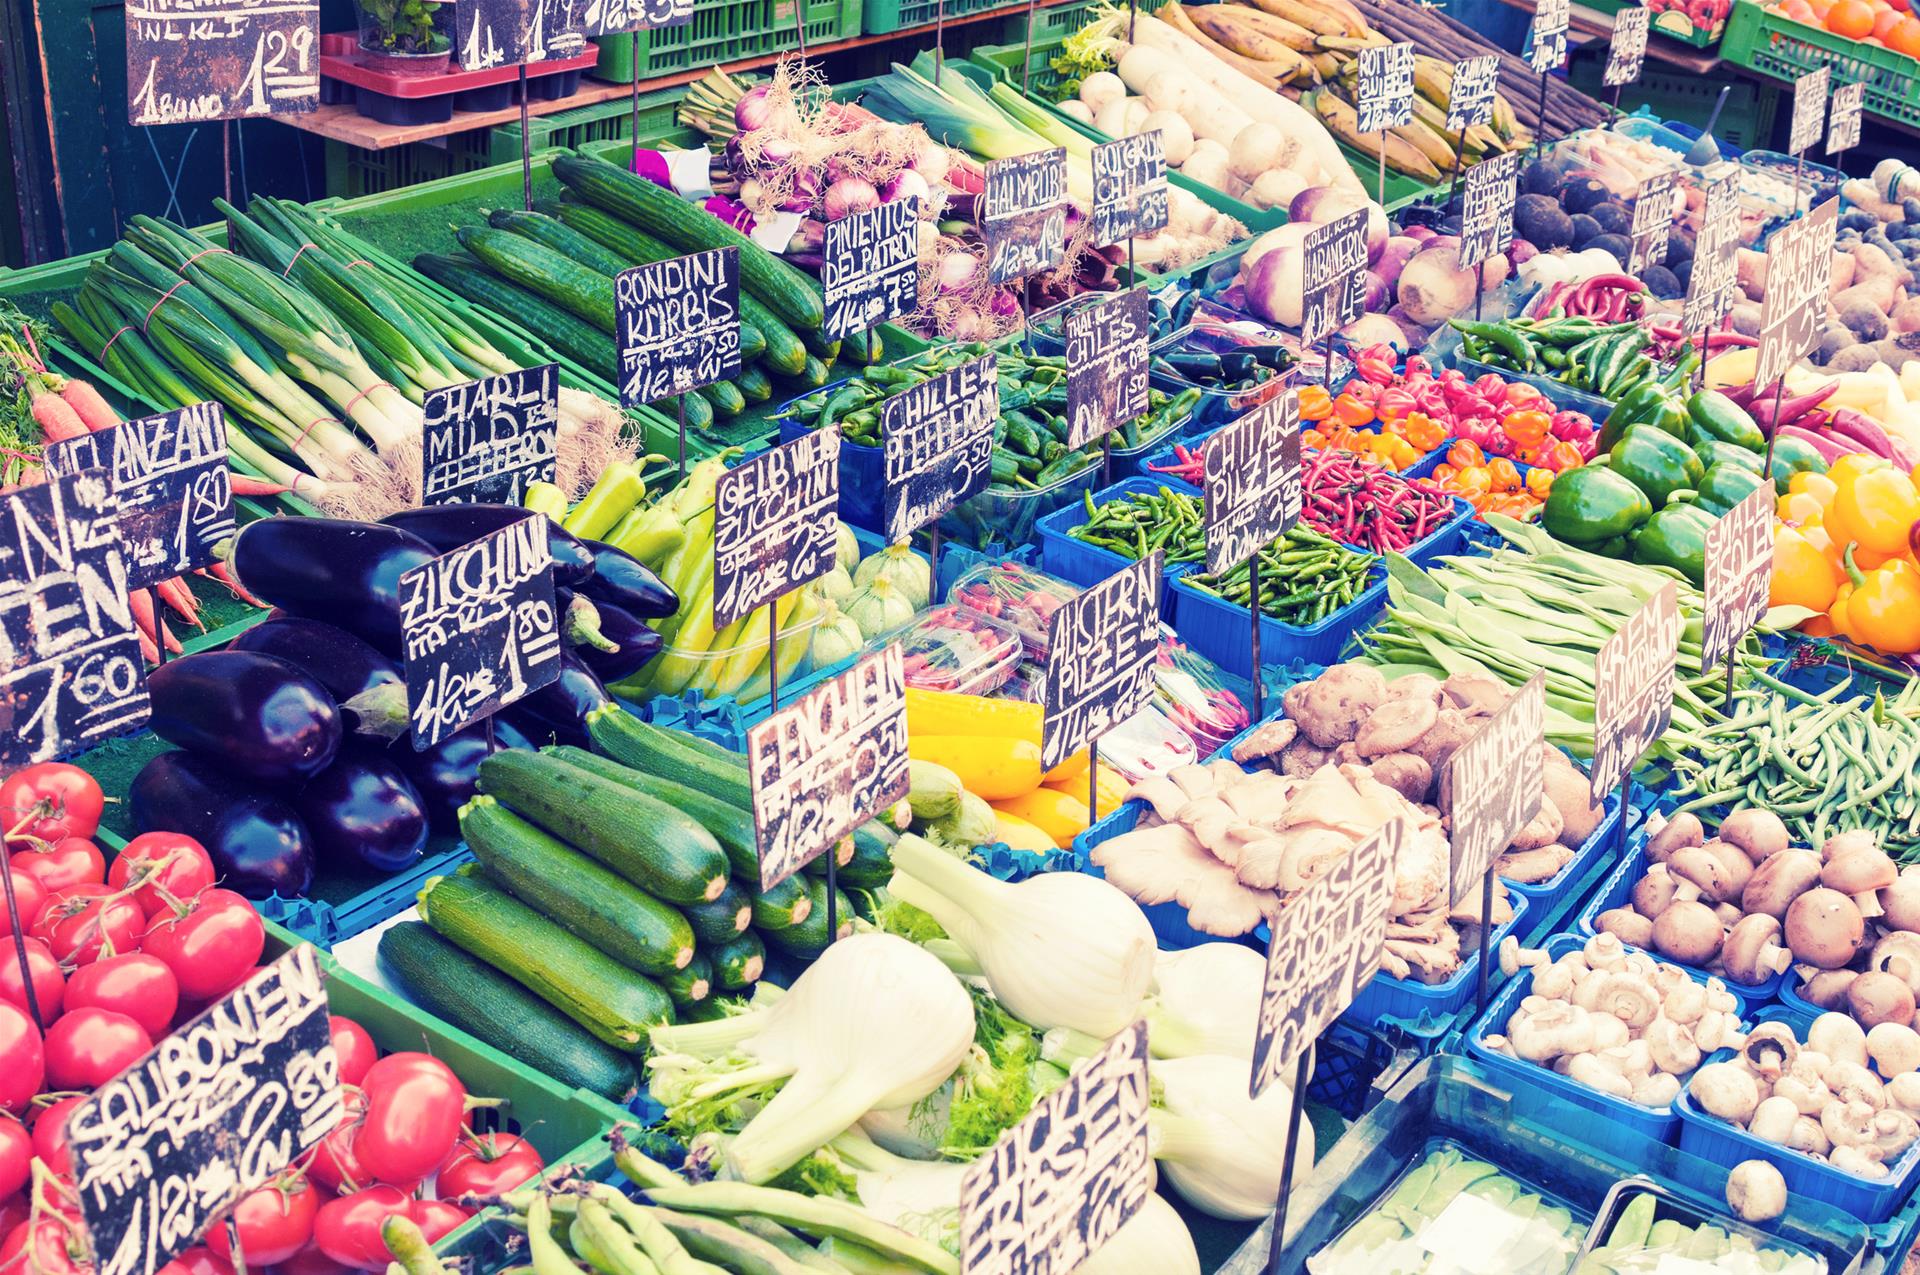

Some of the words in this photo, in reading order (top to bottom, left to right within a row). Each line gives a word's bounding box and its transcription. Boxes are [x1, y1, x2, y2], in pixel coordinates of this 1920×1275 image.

[615, 250, 726, 311] RONDINI
[1303, 221, 1368, 290] HABANEROS
[424, 369, 550, 426] CHARLI
[430, 411, 520, 465] MILD
[715, 458, 839, 553] ZUCCHINI
[1056, 621, 1138, 711] PILZE
[1274, 820, 1398, 962] ERBSEN
